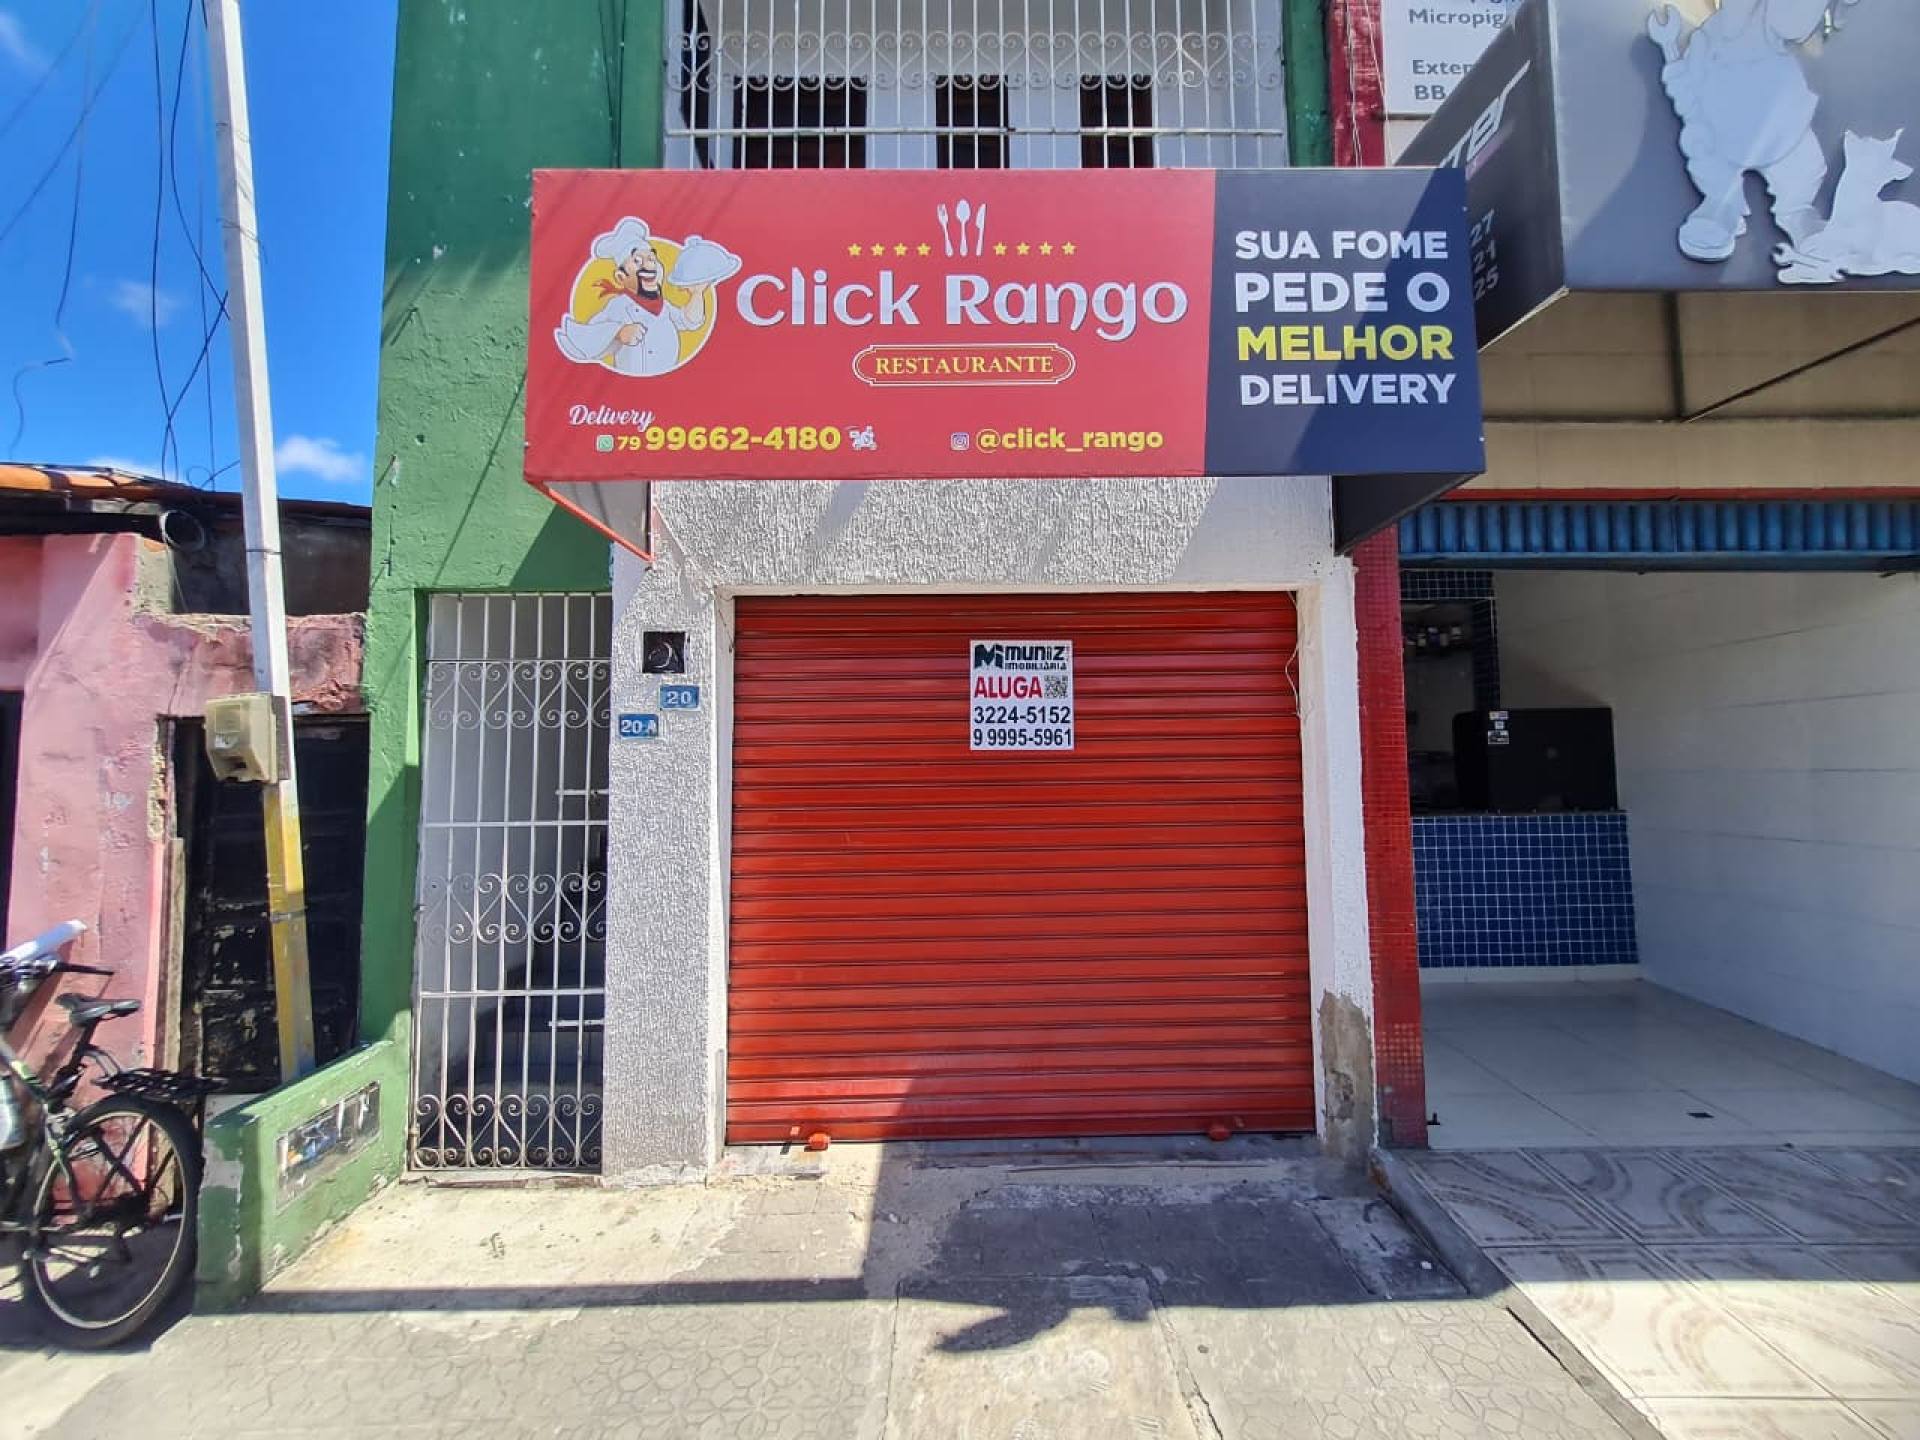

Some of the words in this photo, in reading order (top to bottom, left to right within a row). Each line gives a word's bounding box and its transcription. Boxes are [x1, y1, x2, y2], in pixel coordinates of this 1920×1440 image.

[1235, 230, 1321, 259] SUA
[1332, 230, 1449, 259] FOME
[736, 266, 921, 327] Click
[945, 273, 1189, 342] Rango
[1235, 272, 1389, 313] PEDE
[1406, 272, 1450, 313] O
[1237, 325, 1455, 361] MELHOR
[875, 356, 1054, 375] RESTAURANTE
[1240, 374, 1457, 406] DELIVERY
[569, 404, 655, 433] Delivery
[617, 435, 641, 450] 79
[644, 426, 842, 451] 99662-4180
[976, 428, 1164, 454] @click_rango
[666, 691, 692, 705] 20
[974, 676, 1043, 698] ALUGA
[620, 719, 643, 734] 20
[974, 706, 1071, 724] 3224-5152
[973, 728, 982, 746] 9
[987, 728, 1072, 746] 9995-5961
